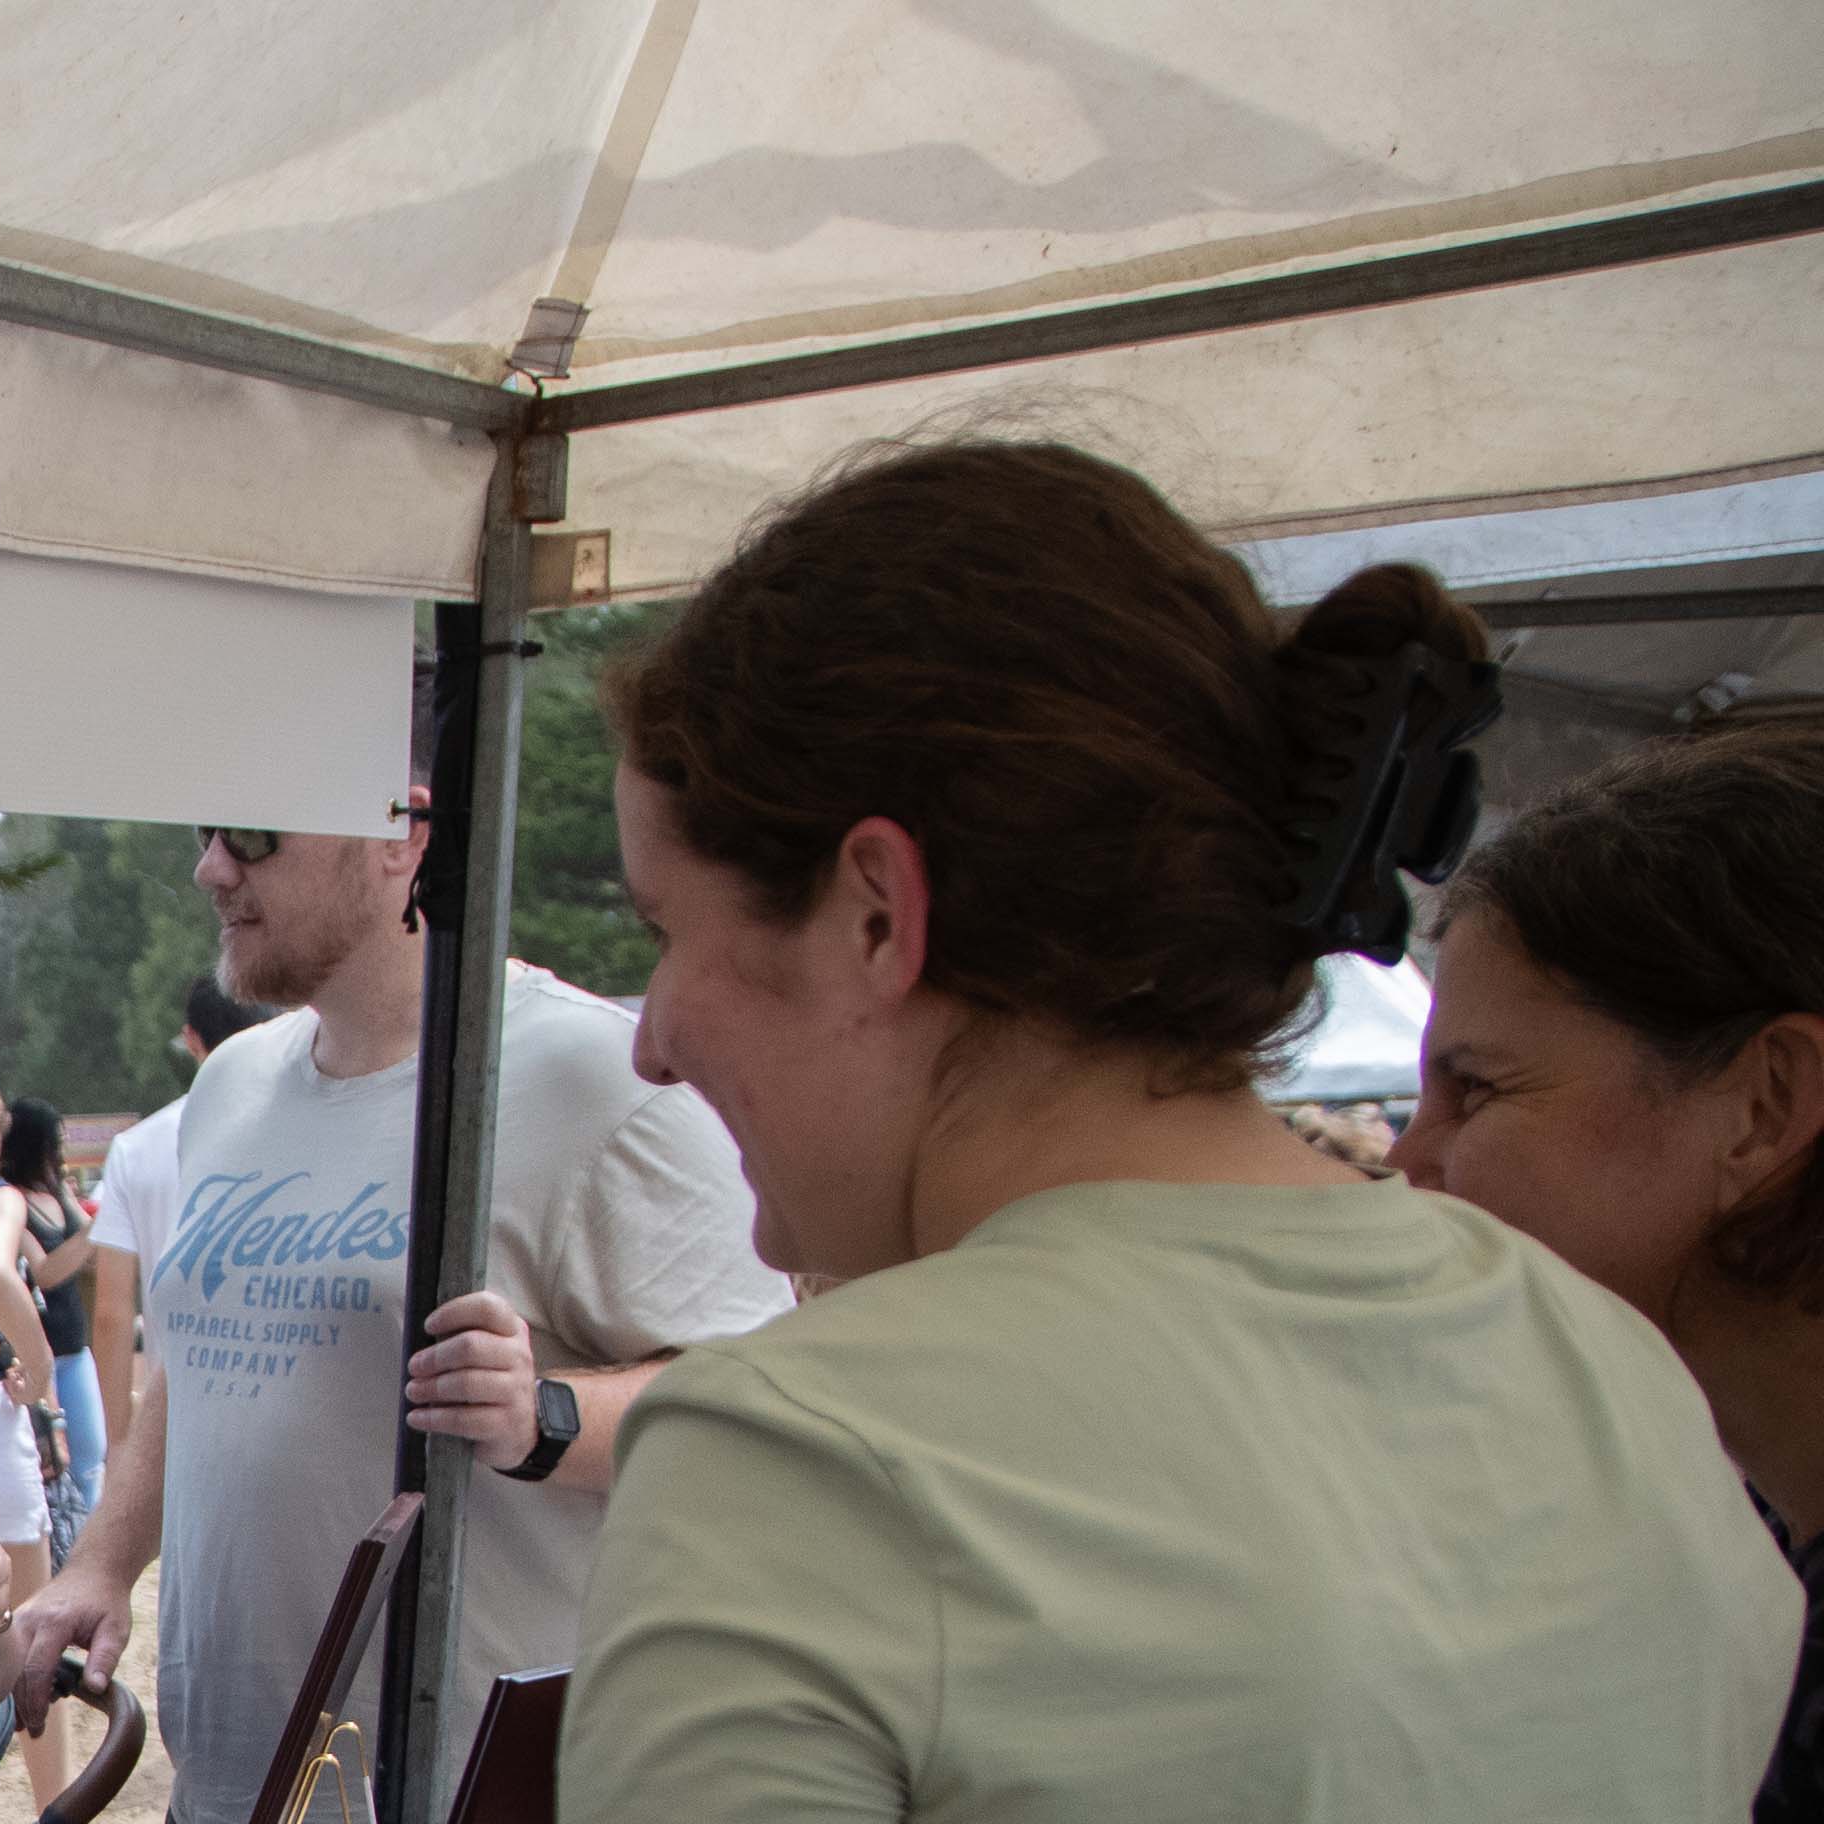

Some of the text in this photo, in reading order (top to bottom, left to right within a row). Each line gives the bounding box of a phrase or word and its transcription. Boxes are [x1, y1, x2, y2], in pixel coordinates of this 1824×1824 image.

[150, 1170, 412, 1302] Mendes
[244, 1275, 383, 1313] CHICAGO.
[167, 1312, 340, 1346] APPARELL SUPPLY
[186, 1346, 296, 1376] COMPANY
